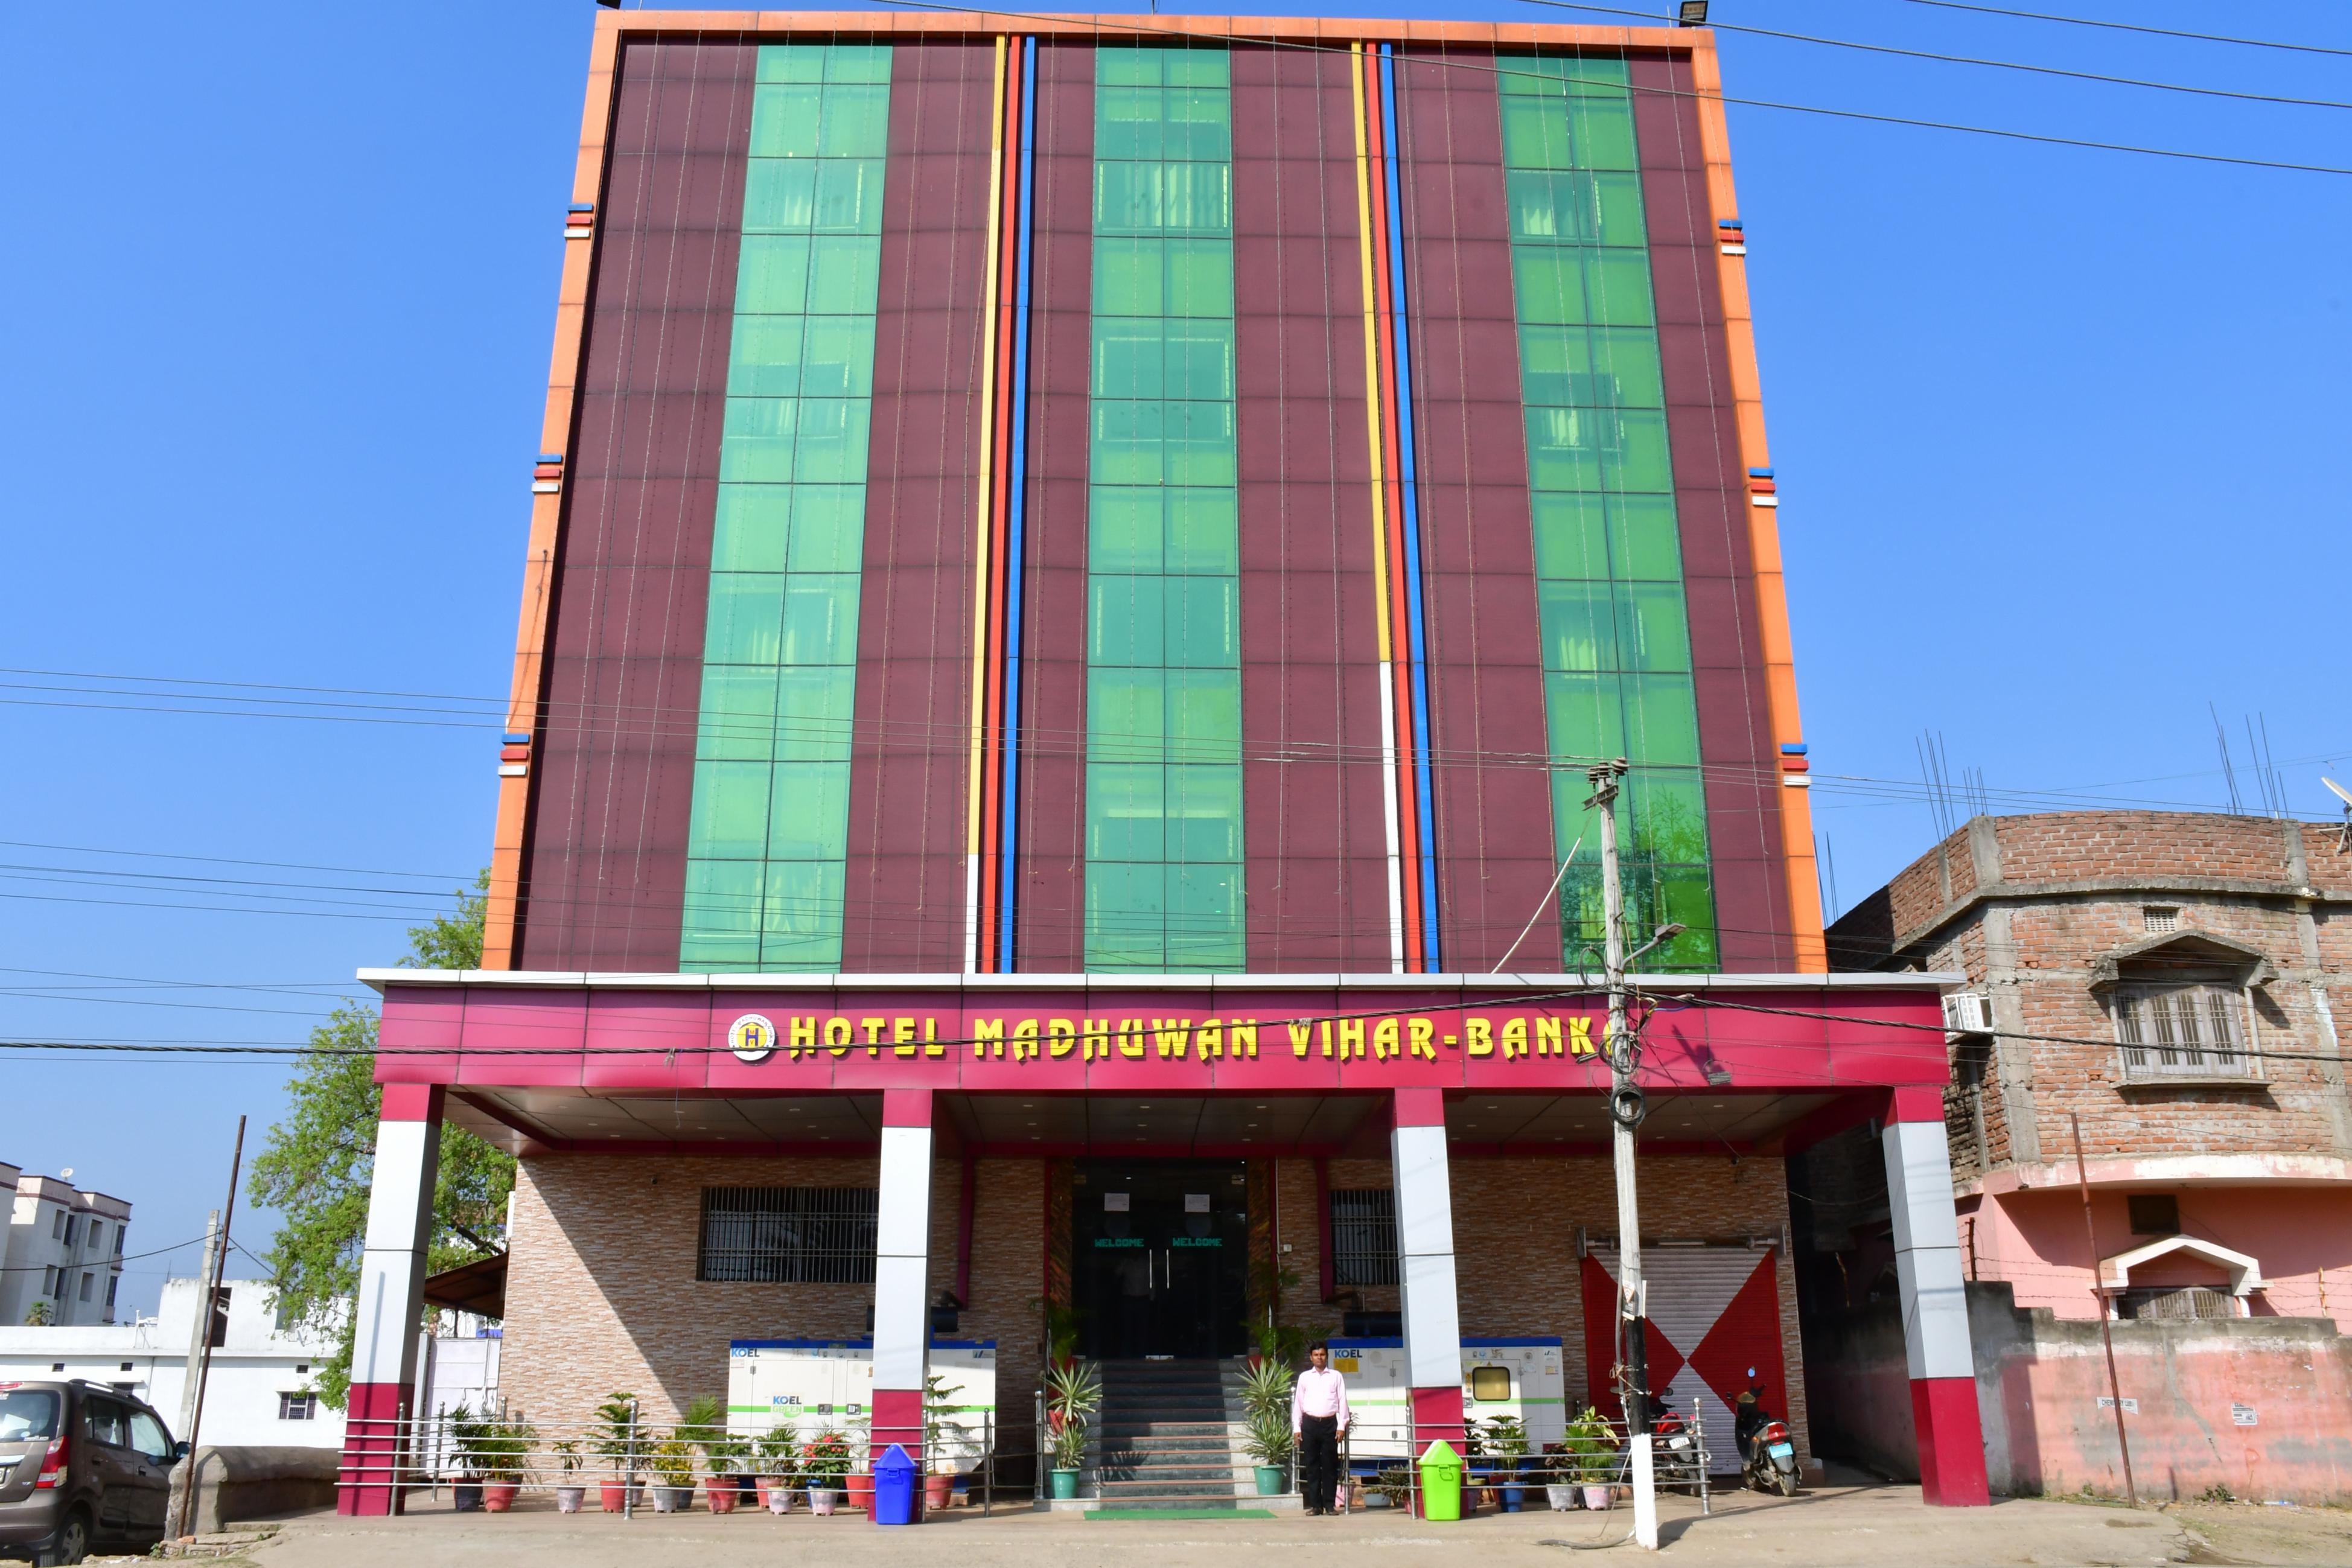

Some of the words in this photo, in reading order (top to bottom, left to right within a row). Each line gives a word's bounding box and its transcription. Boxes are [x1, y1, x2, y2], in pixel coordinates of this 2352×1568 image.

[789, 1017, 944, 1059] HOTEL
[974, 1018, 1257, 1061] MADHUWAN
[1095, 1238, 1144, 1247] WELCOME
[1173, 1237, 1222, 1246] WELCOME
[731, 1348, 760, 1357] KOEL
[1334, 1349, 1362, 1358] KOEL
[773, 1395, 802, 1404] KOEL
